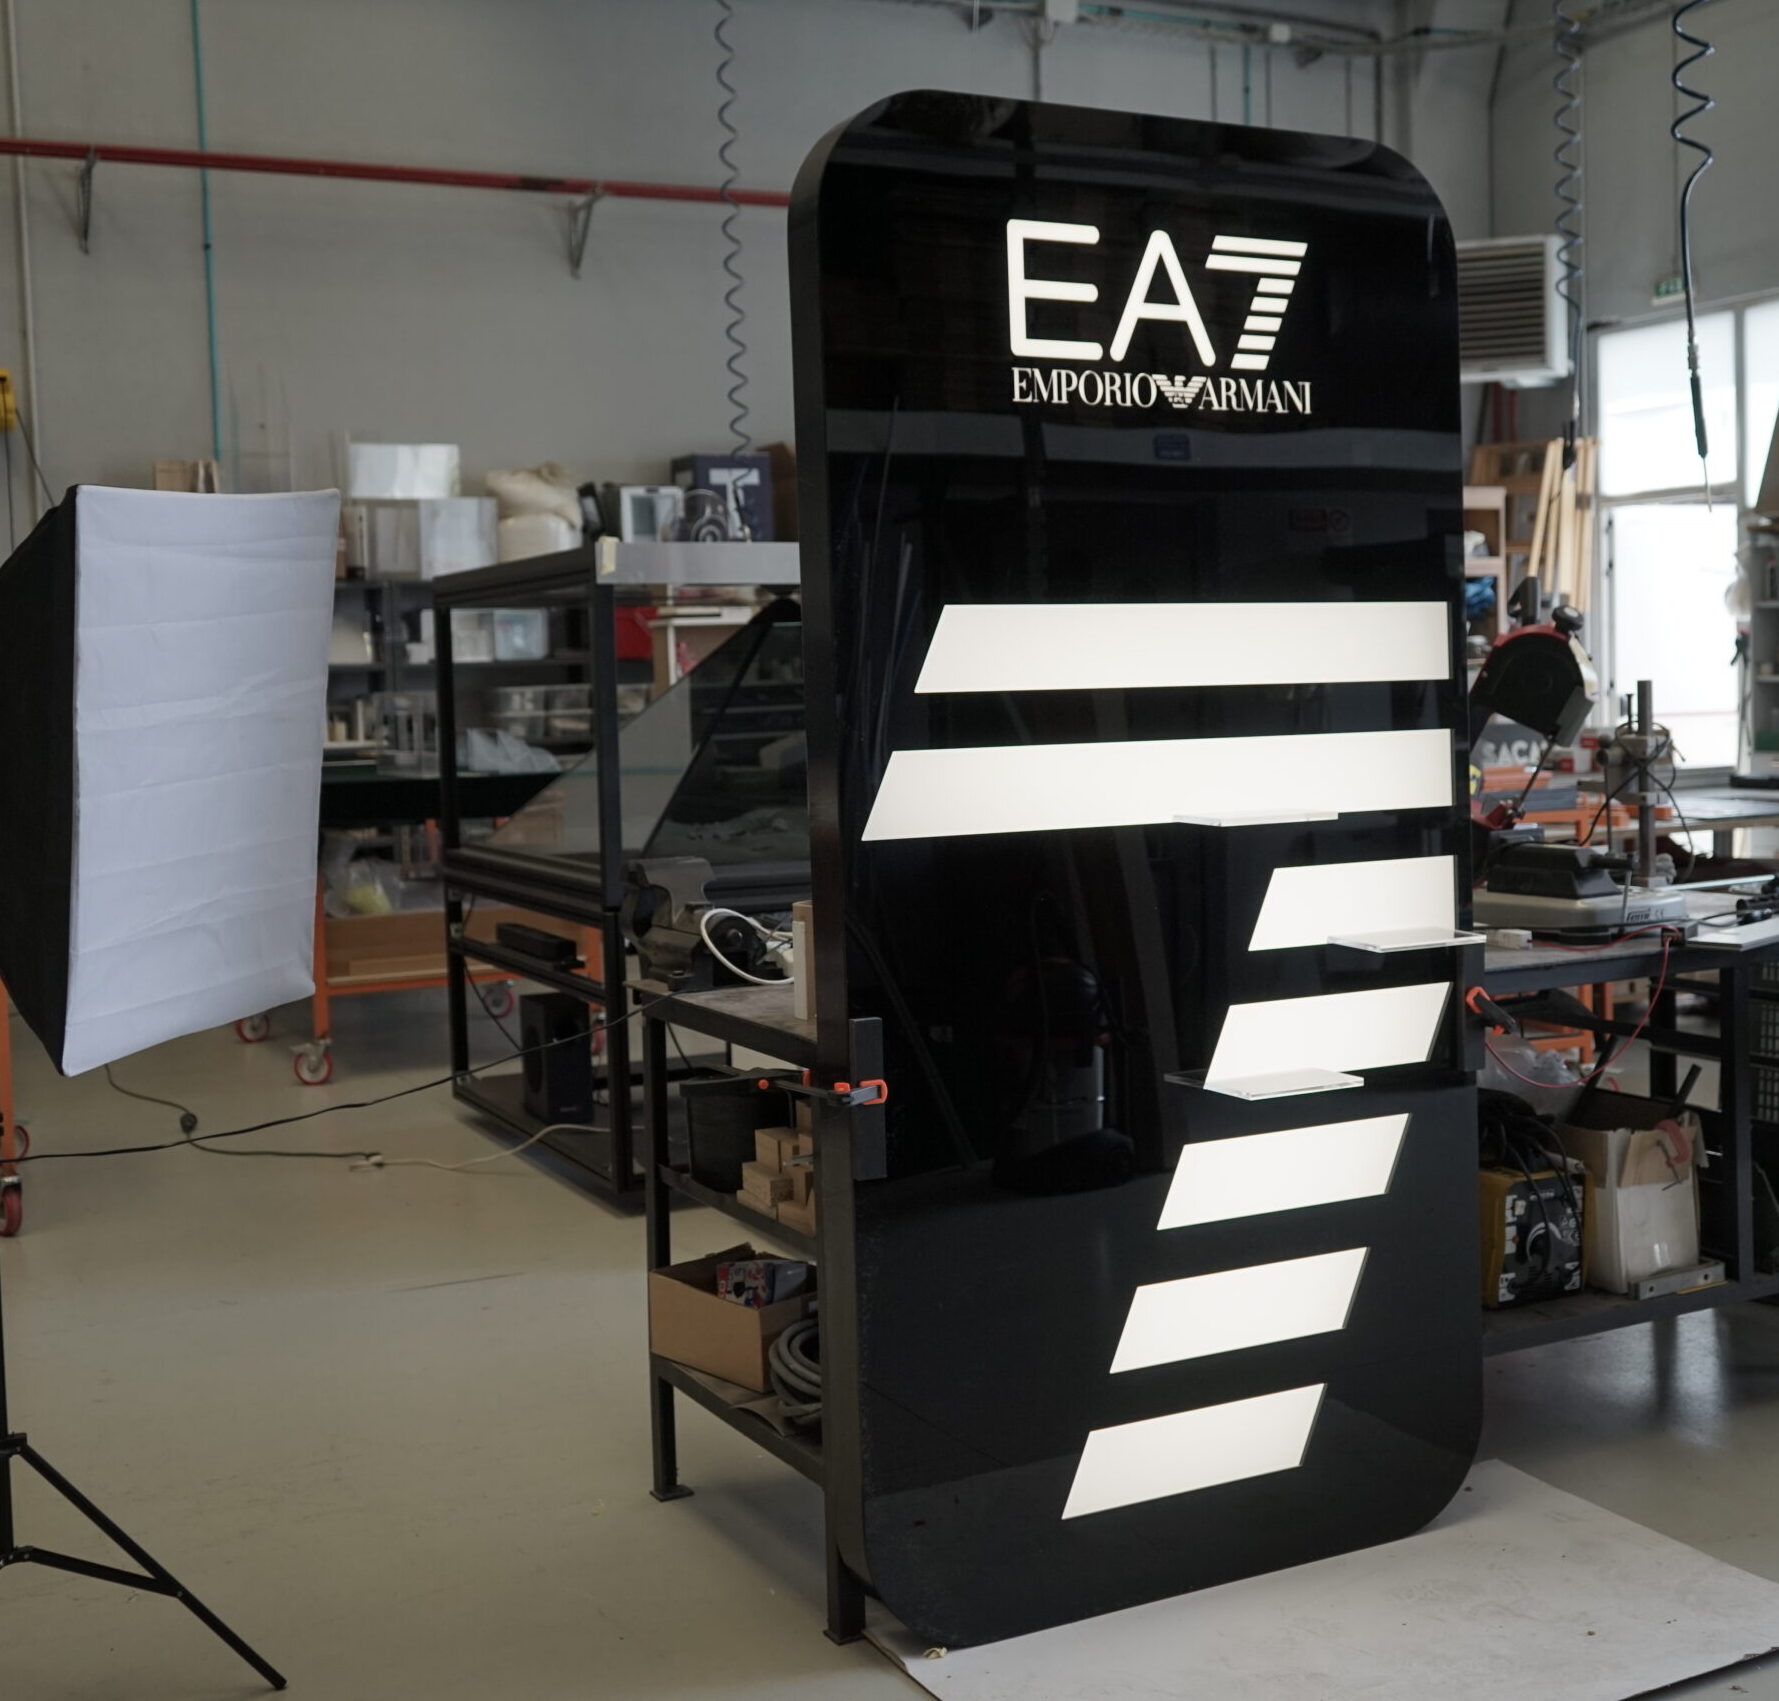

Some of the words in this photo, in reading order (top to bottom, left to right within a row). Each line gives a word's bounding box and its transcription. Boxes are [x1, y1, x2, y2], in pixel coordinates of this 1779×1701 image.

[1006, 218, 1308, 370] EA7
[1011, 366, 1158, 409] EMPORIO
[1198, 377, 1312, 415] ARMANI
